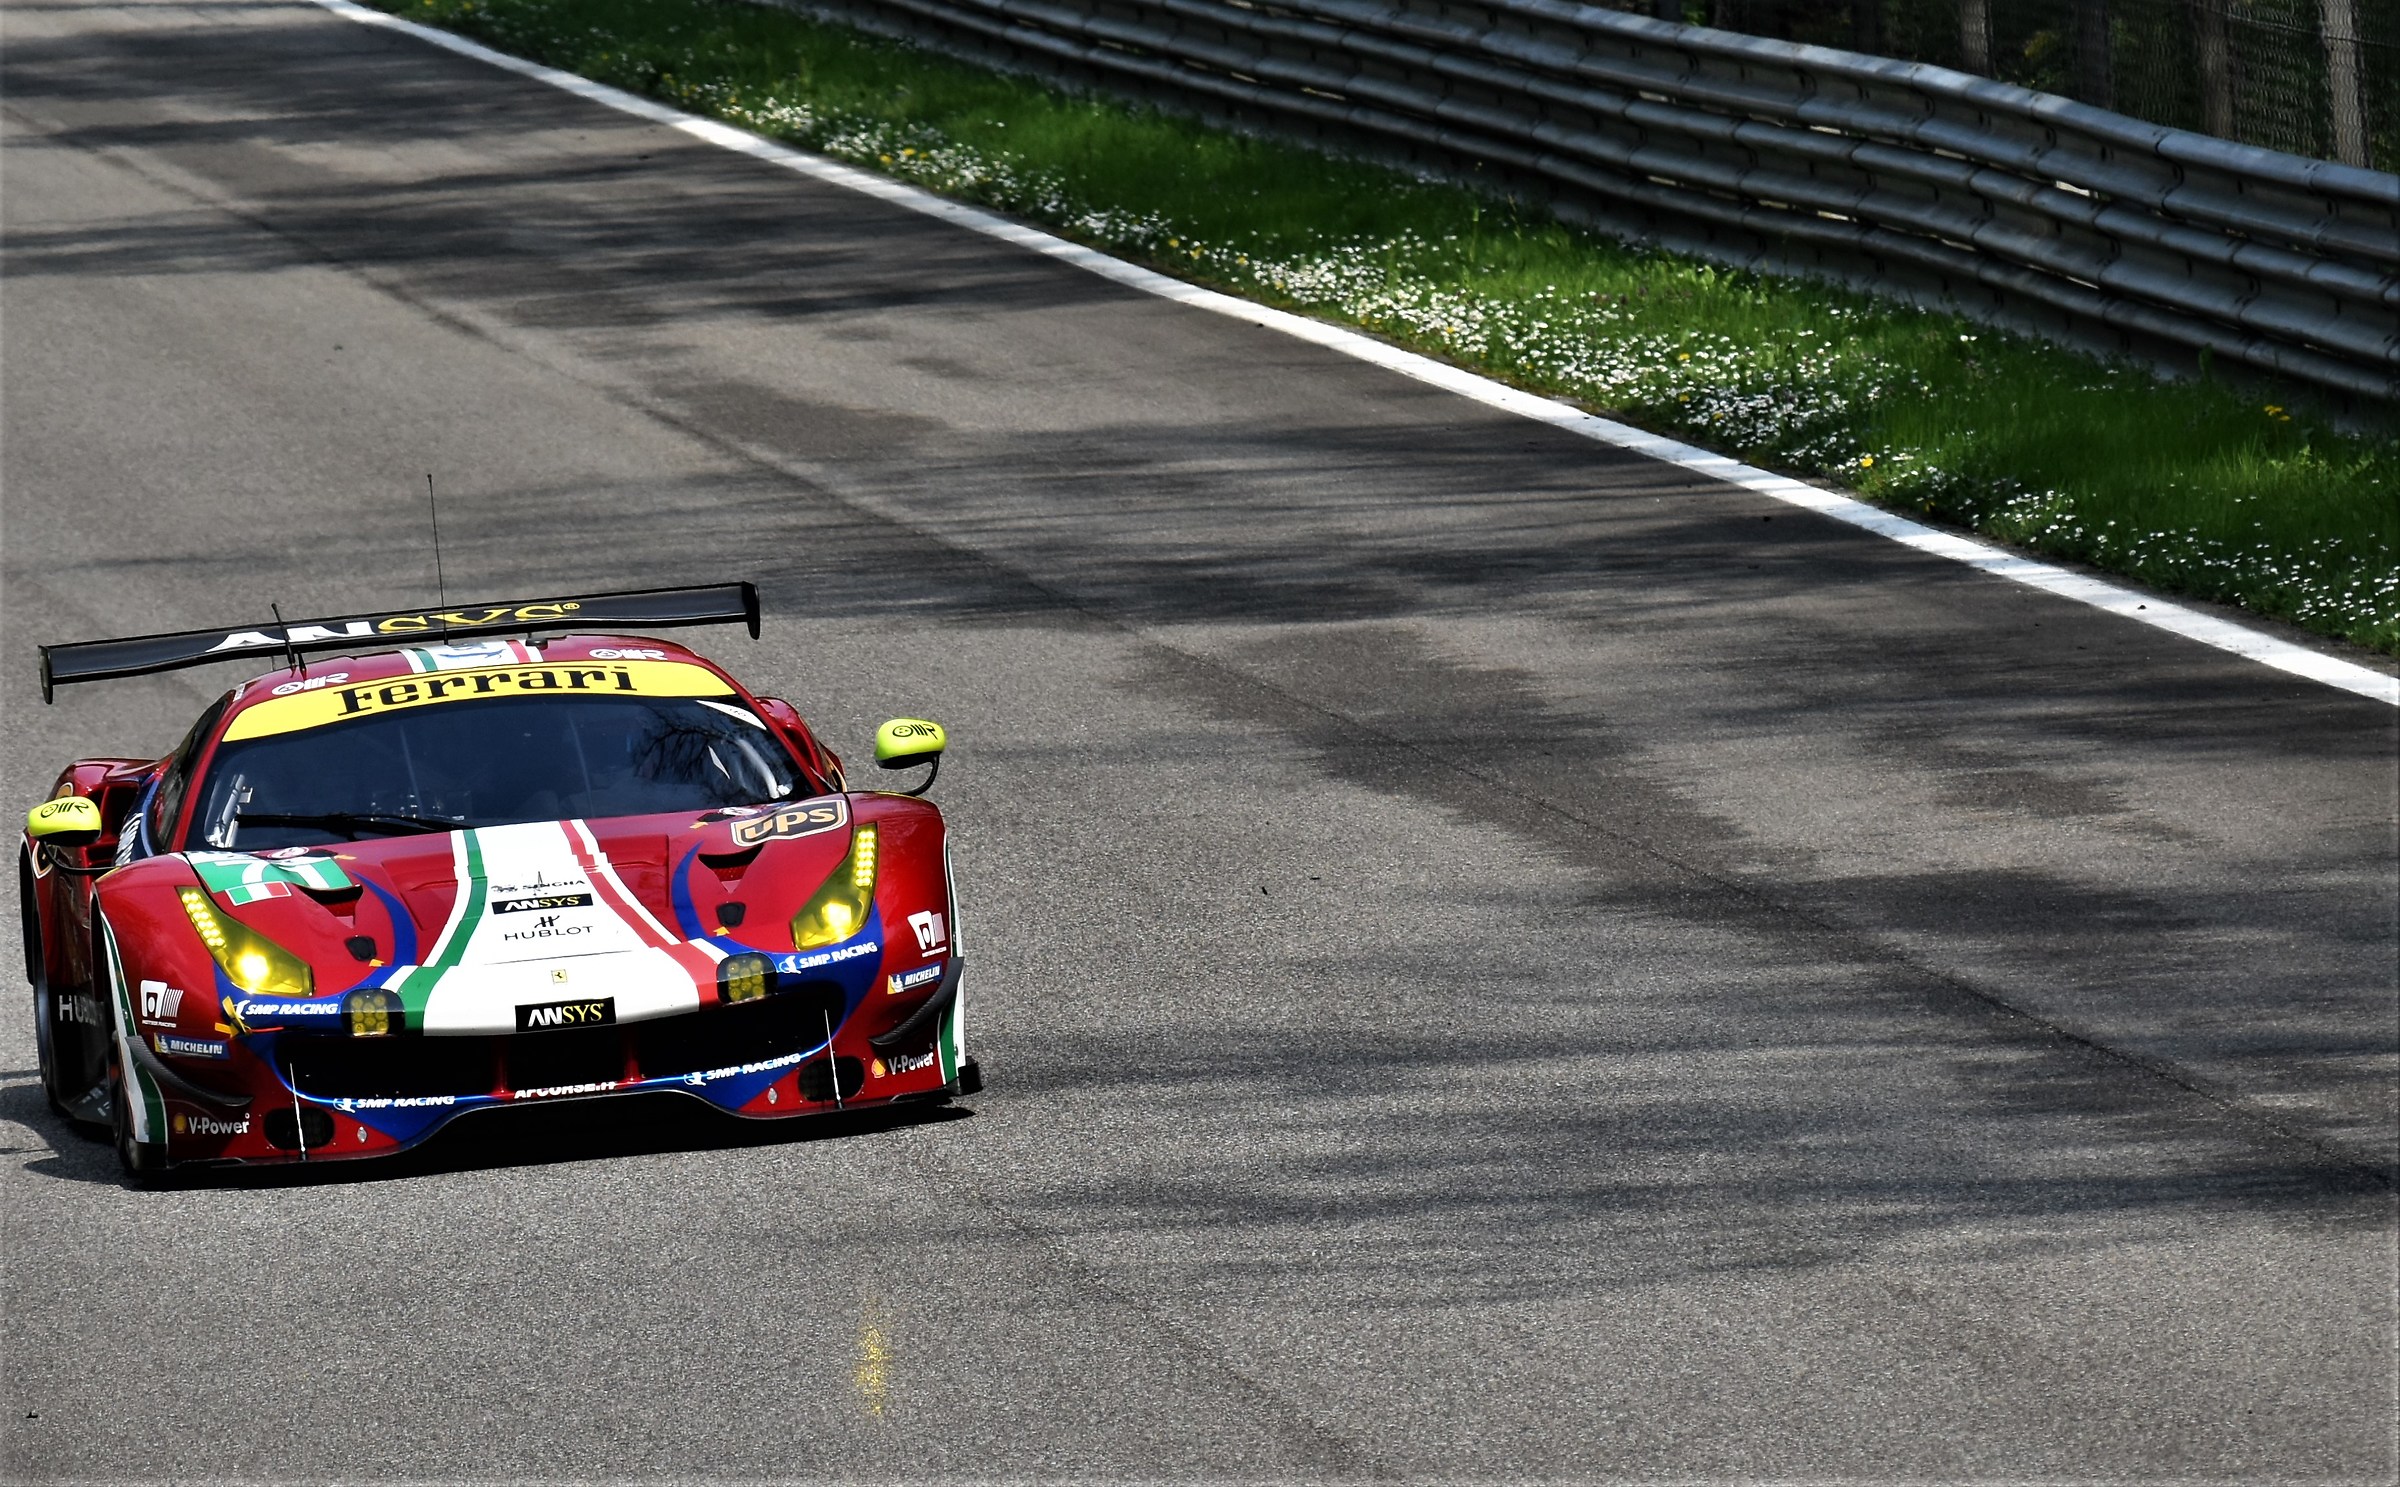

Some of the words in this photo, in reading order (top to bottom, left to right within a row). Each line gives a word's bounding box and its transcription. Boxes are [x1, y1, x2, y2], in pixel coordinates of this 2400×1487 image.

[333, 665, 638, 716] Ferrari
[505, 896, 579, 911] ANSYS
[504, 926, 594, 941] HUBLOT
[800, 953, 831, 969] SMP
[832, 942, 878, 962] RACING
[904, 965, 941, 986] MICHELIN
[246, 1003, 279, 1016] SMP
[279, 1003, 339, 1015] RACING
[528, 1003, 603, 1027] ANSYS
[170, 1039, 223, 1054] MICHELIN
[706, 1066, 742, 1080] SMP
[742, 1053, 801, 1074] RACING
[888, 1052, 934, 1076] V-Power
[356, 1097, 394, 1109] SMP
[394, 1095, 455, 1107] RACING
[188, 1115, 250, 1135] V-Power
